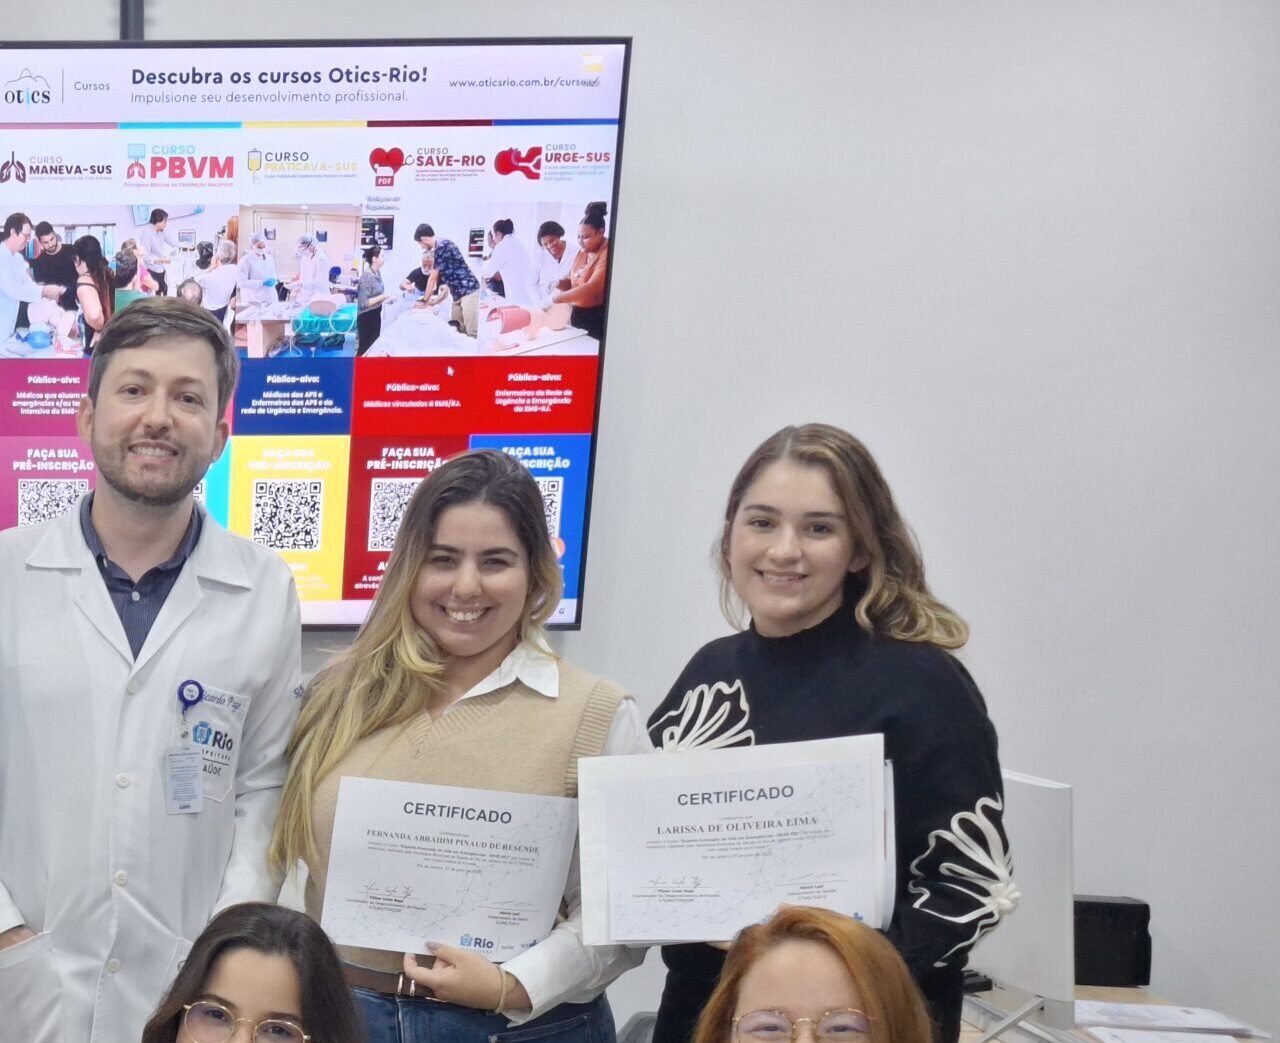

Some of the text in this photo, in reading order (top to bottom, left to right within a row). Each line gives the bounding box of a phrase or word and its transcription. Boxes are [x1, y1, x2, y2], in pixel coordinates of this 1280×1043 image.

[131, 66, 428, 86] Descubra os cursos Otics-Rio!
[74, 81, 111, 92] Cursos
[131, 89, 409, 105] Impulsione seu desenvolvimento profissional.
[152, 145, 195, 155] CURSO
[29, 156, 63, 164] CURSO
[265, 152, 309, 161] CURSO
[416, 155, 485, 166] SAVE-RIO
[545, 152, 610, 162] URGE-SUS
[29, 165, 112, 174] MANEVA-SUS
[150, 157, 234, 179] PBVM
[28, 376, 80, 384] Público-alvo:
[266, 375, 320, 383] Público-alvo:
[508, 373, 562, 381] Público-alvo:
[386, 383, 440, 392] Público-alvo:
[27, 449, 78, 461] FAÇA SUA
[382, 447, 434, 460] FAÇA SUA
[533, 447, 555, 456] SUA
[13, 459, 94, 473] PRÉ-INSCRIÇÃO
[212, 730, 233, 751] Rio
[677, 785, 794, 806] CERTIFICADO
[403, 801, 512, 824] CERTIFICADO
[657, 816, 817, 835] LARISSA DE OLIVEIRA LIMA
[367, 829, 540, 854] FERNANDA ABRAHIM PINAUD DE RESENDE
[473, 937, 494, 949] Rio
